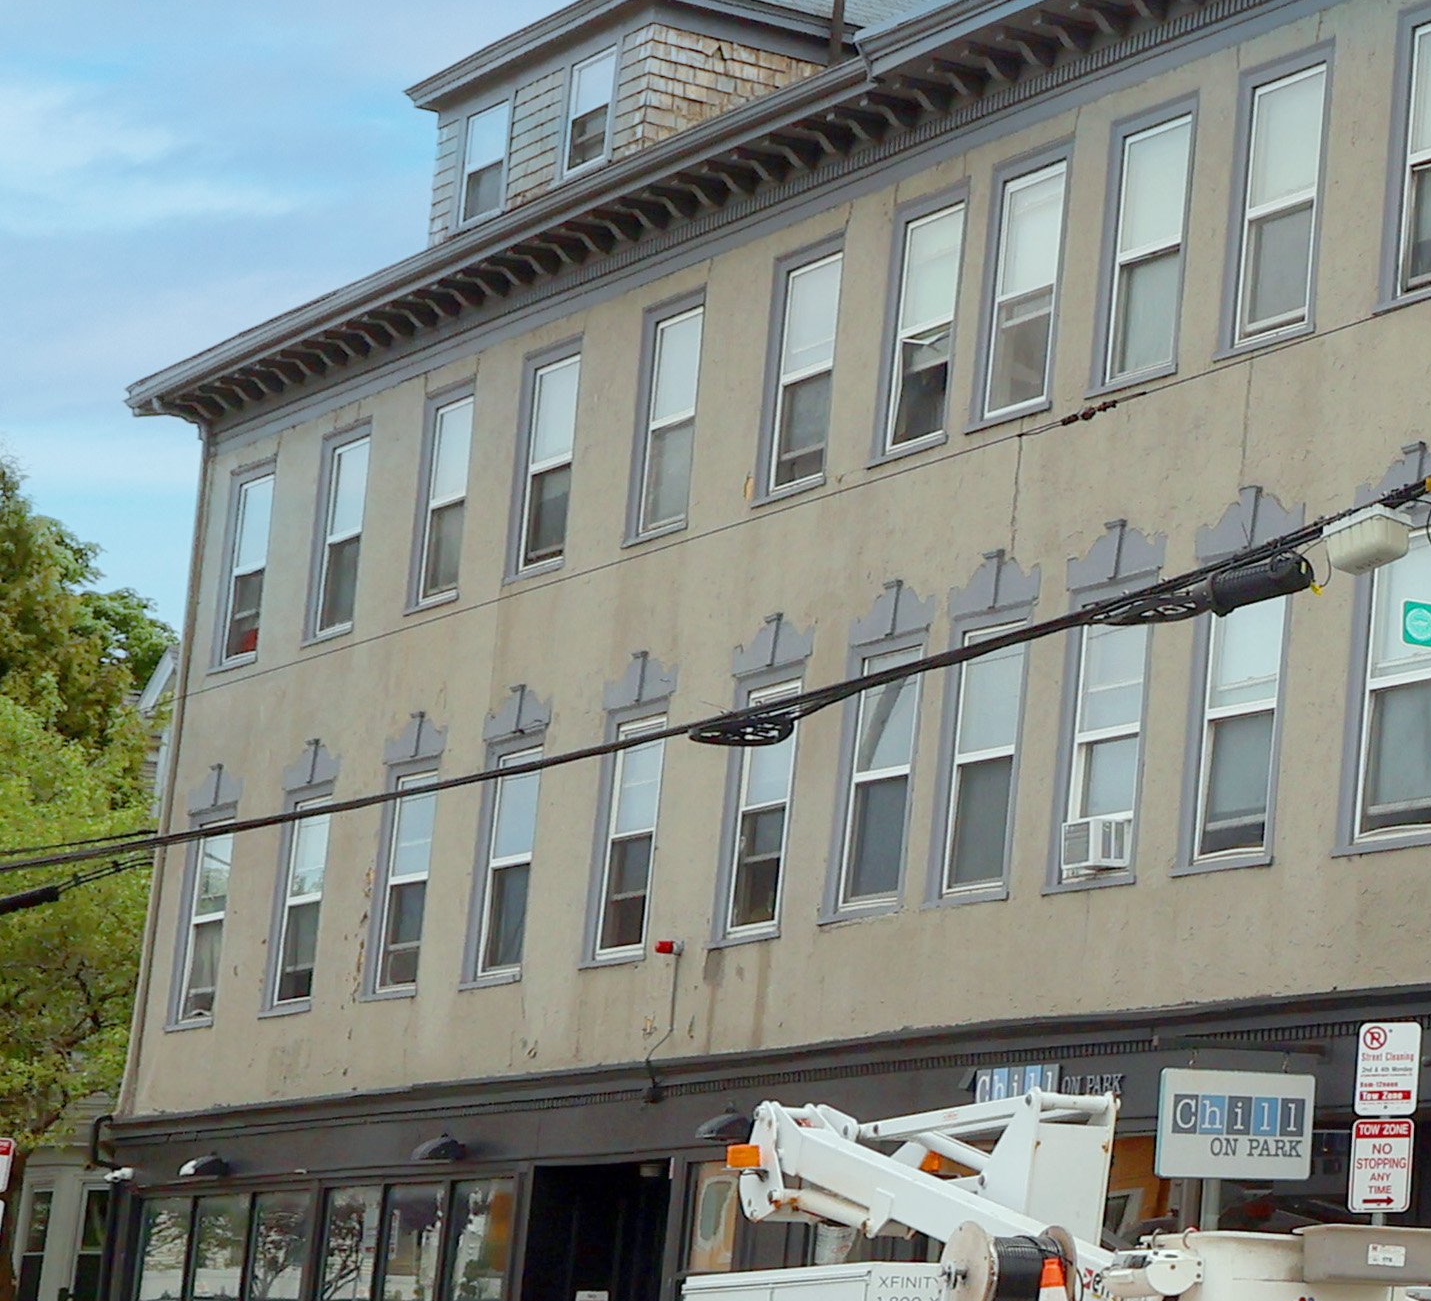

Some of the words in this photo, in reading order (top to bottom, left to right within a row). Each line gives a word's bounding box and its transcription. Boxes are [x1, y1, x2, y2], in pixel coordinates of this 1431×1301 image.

[1062, 1077, 1081, 1094] ON
[1087, 1074, 1123, 1094] PARK
[1362, 1092, 1379, 1100] Tow
[1381, 1091, 1403, 1100] Zone
[1176, 1098, 1298, 1132] Chill
[1358, 1124, 1380, 1135] TOW
[1382, 1123, 1409, 1135] ZONE
[1210, 1138, 1238, 1156] ON
[1246, 1138, 1302, 1158] PARK
[1372, 1143, 1393, 1155] NO
[1356, 1157, 1407, 1169] STOPPING
[1370, 1173, 1391, 1181] ANY
[1368, 1185, 1392, 1194] TIME
